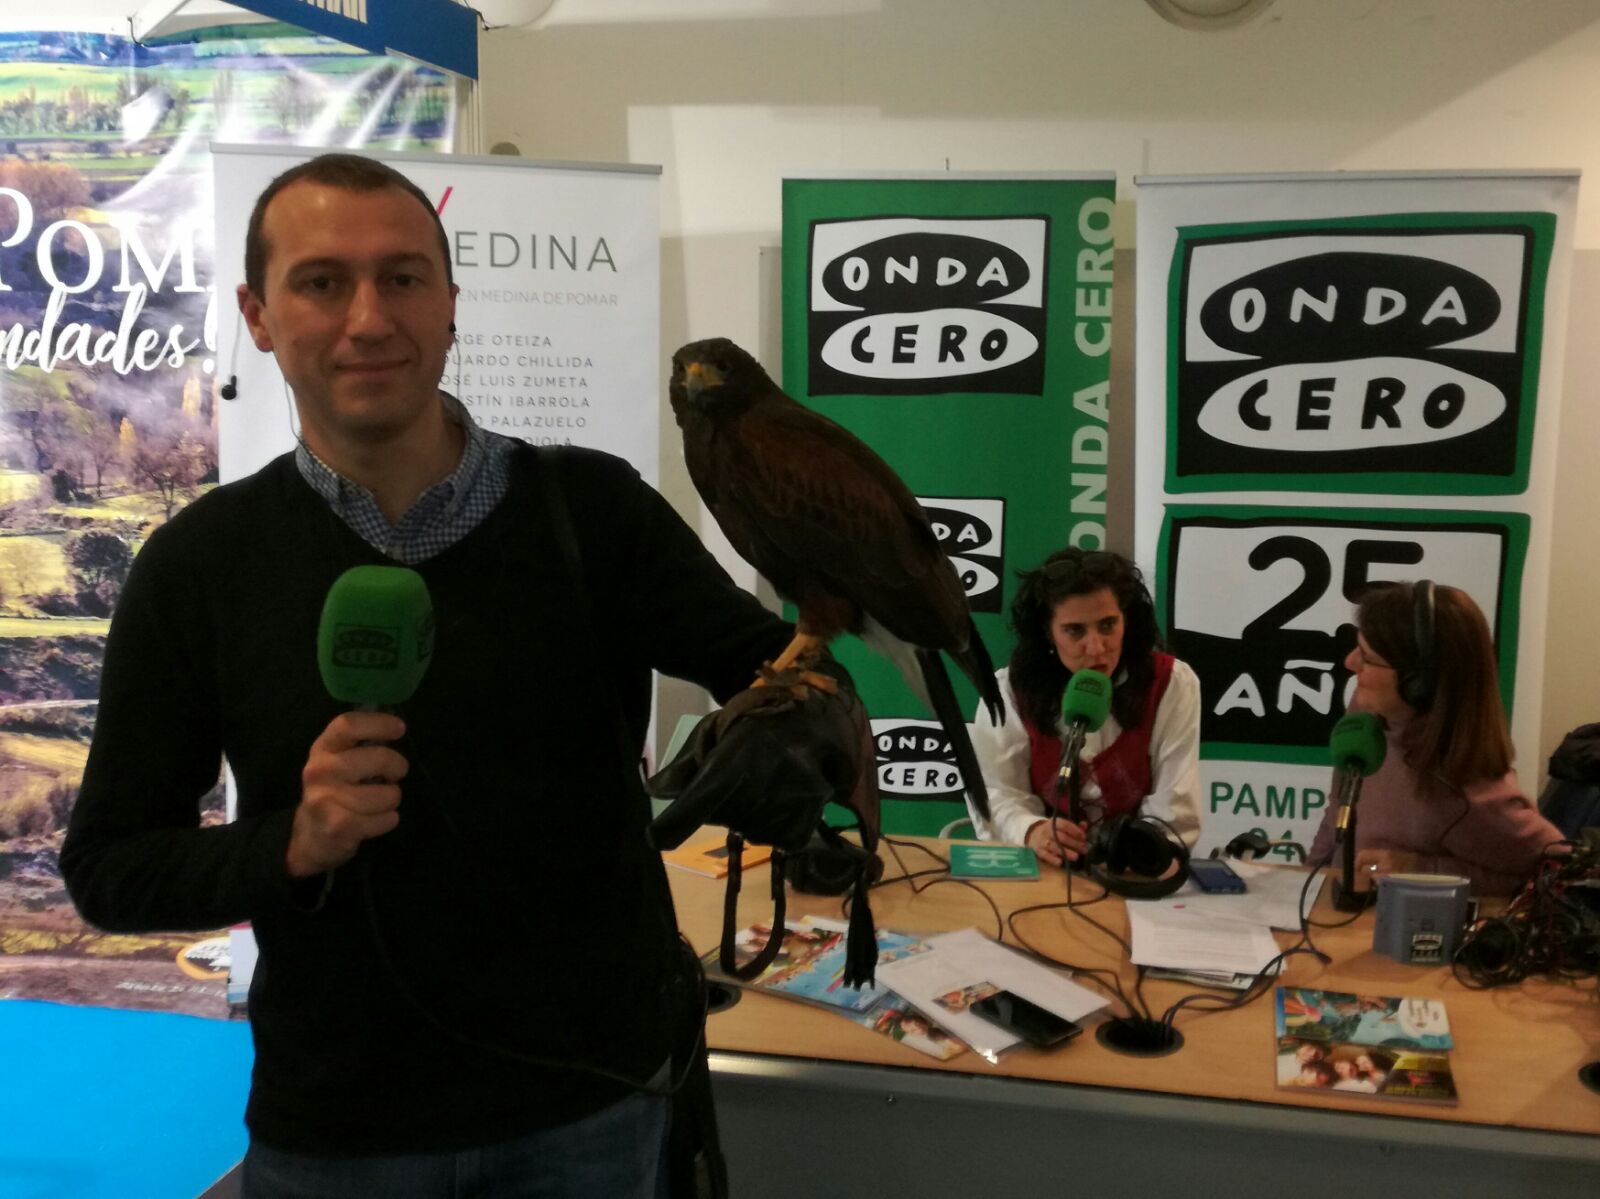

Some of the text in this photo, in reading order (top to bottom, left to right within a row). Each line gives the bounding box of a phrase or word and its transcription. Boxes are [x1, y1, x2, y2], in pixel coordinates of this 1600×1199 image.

[0, 187, 217, 293] POM
[454, 231, 617, 272] EDINA
[842, 255, 1009, 292] ONDA
[481, 289, 541, 304] MEDINA
[543, 291, 563, 304] DE
[566, 292, 619, 307] POMAR
[1229, 284, 1468, 333] ONDA
[0, 281, 217, 375] ndades!
[491, 333, 552, 348] OTEIZA
[850, 323, 1008, 364] CERO
[440, 373, 588, 389] OSÉ LUIS ZUMETA
[516, 355, 593, 368] CHILLIDA
[1068, 196, 1116, 551] ONDA CERO
[510, 395, 591, 409] IBARROLA
[1237, 377, 1466, 431] CERO
[491, 416, 587, 429] PALAZUELO
[1213, 659, 1358, 718] AÑ
[883, 767, 959, 788] CERO
[1210, 781, 1326, 821] PAMP
